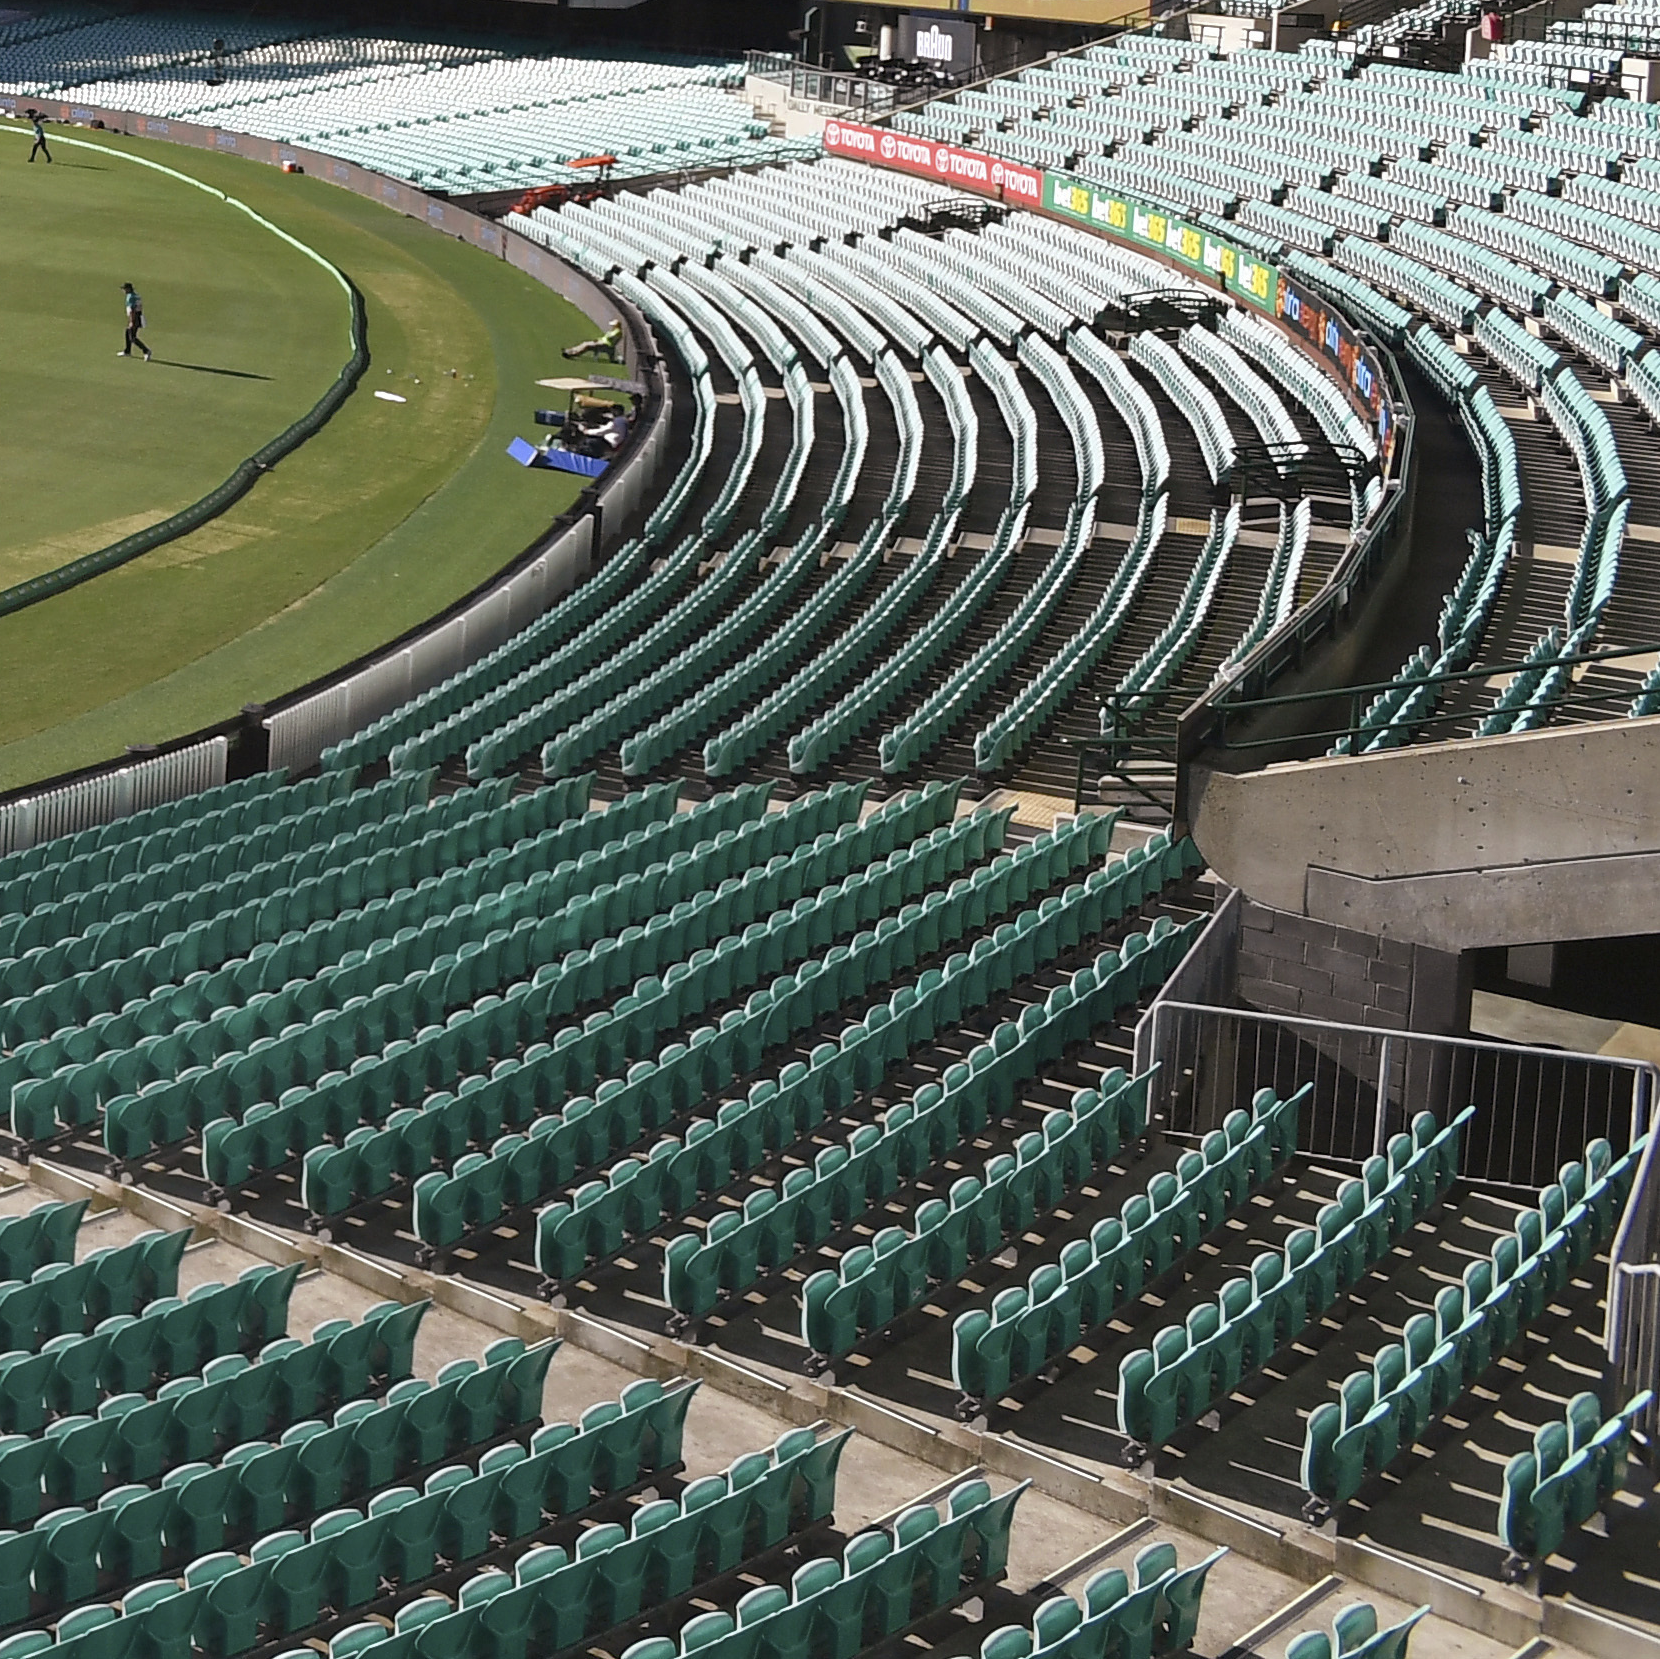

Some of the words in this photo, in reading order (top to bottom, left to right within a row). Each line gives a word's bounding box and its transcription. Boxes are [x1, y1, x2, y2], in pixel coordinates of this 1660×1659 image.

[916, 25, 953, 62] BRAUN
[841, 128, 876, 152] TOYOTA
[897, 141, 931, 166] TOYOTA
[950, 154, 988, 181] TOYOTA
[1004, 169, 1038, 198] TOYOTA
[1054, 179, 1089, 214] bet365
[1091, 193, 1127, 228] bet365
